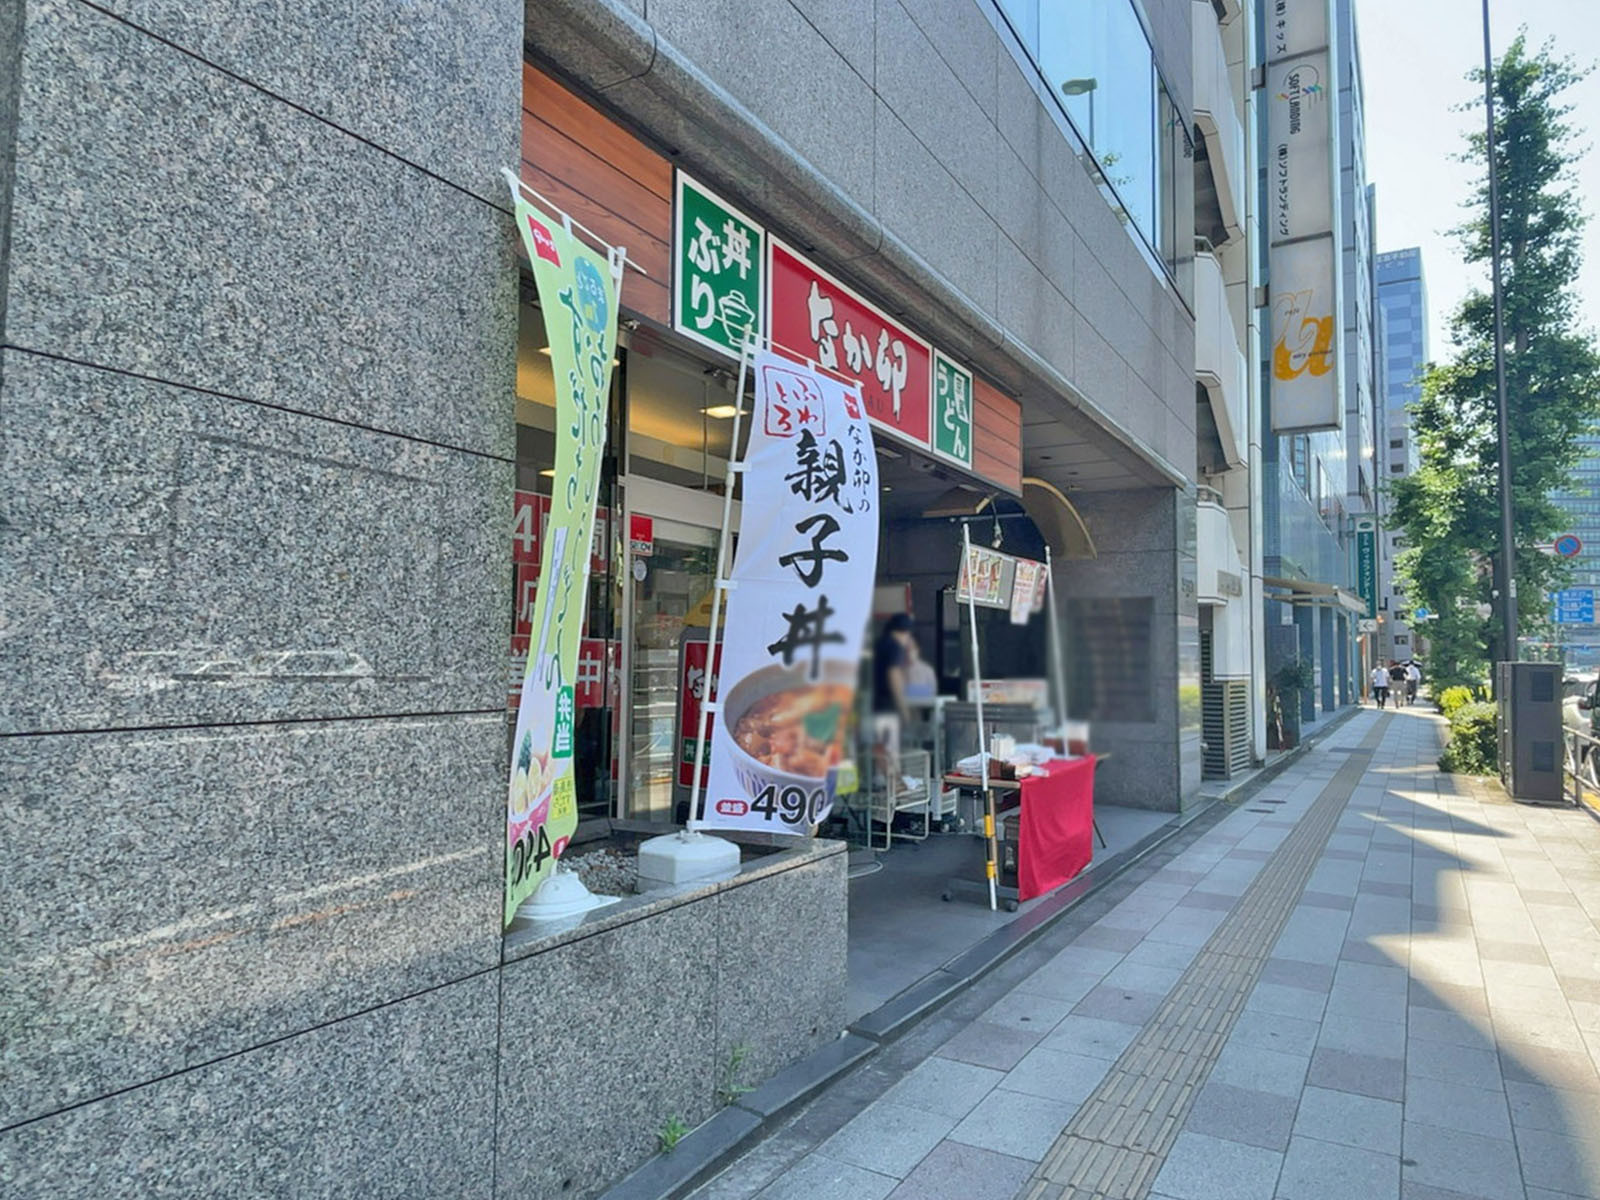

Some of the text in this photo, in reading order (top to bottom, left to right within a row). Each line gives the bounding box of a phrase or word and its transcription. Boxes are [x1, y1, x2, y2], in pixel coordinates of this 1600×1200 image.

[807, 279, 908, 422] なか卯
[767, 428, 853, 679] 親子丼
